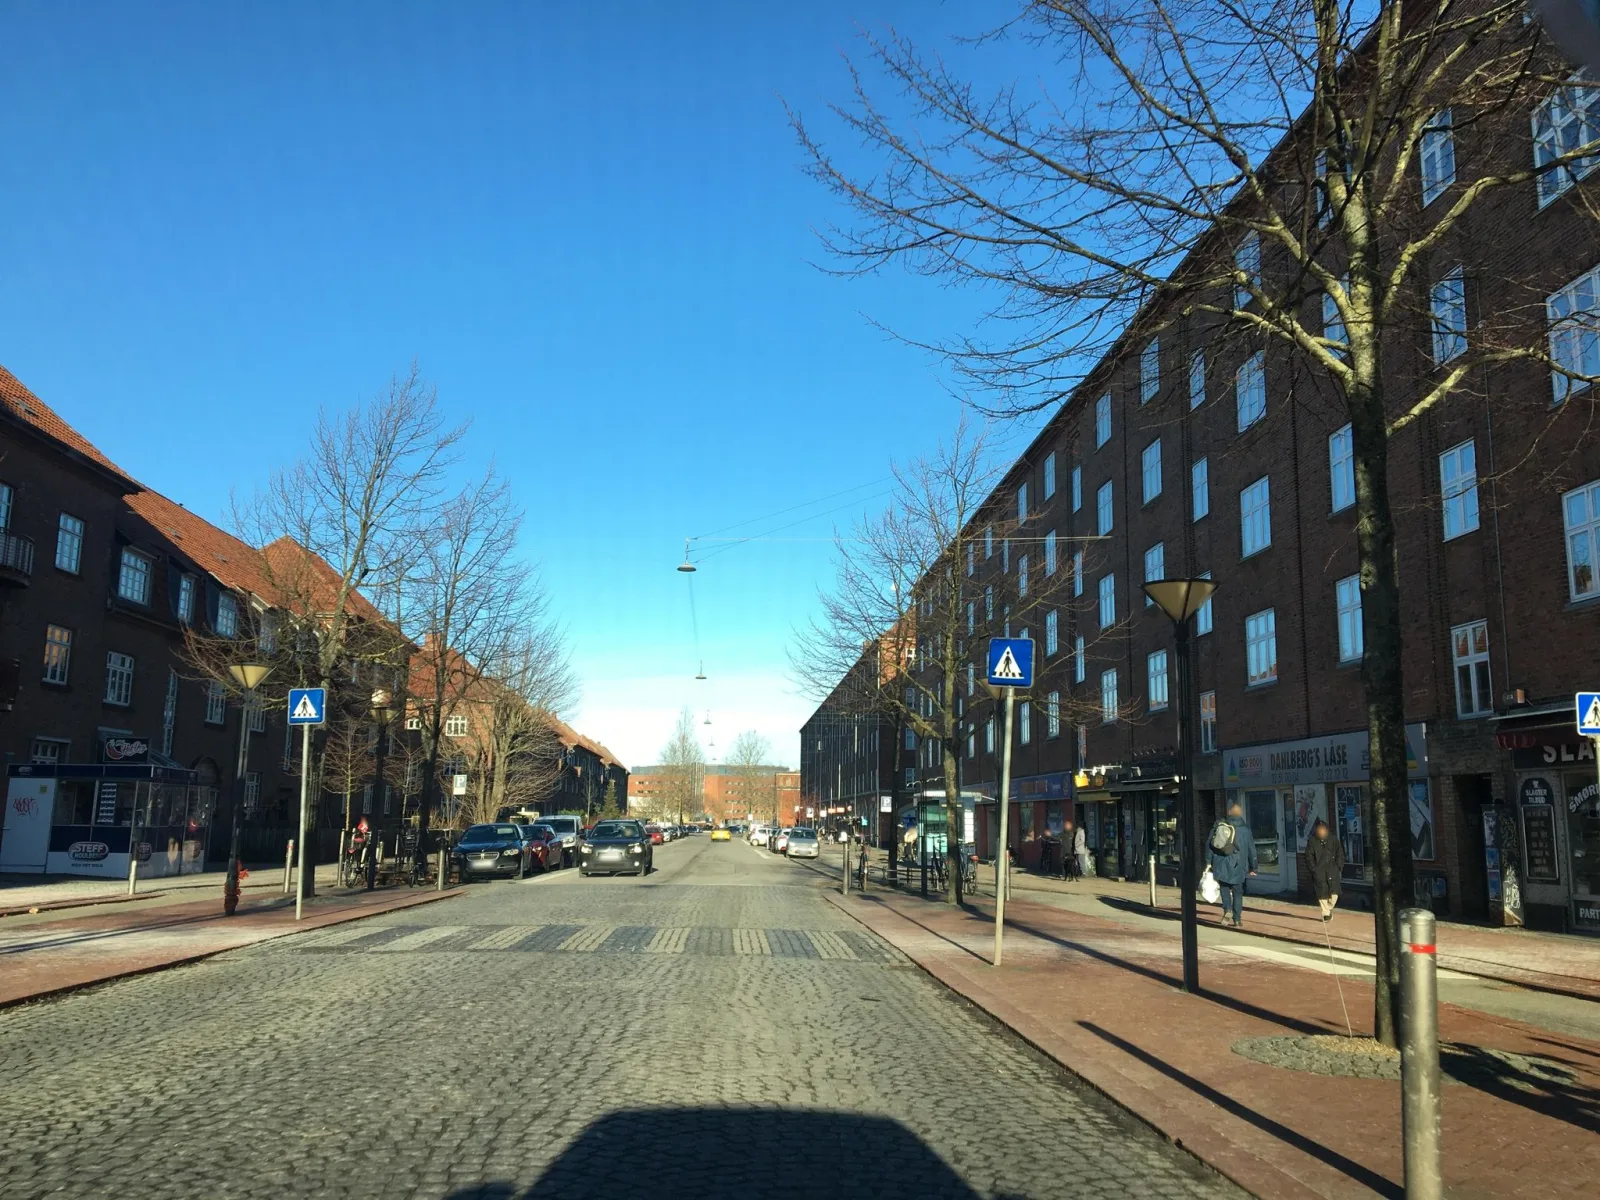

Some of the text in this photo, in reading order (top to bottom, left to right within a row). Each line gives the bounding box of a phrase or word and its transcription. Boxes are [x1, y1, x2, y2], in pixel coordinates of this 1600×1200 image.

[1270, 747, 1320, 771] DAHLBERG'S
[1323, 740, 1348, 767] LÅSE
[75, 843, 104, 853] STEFF
